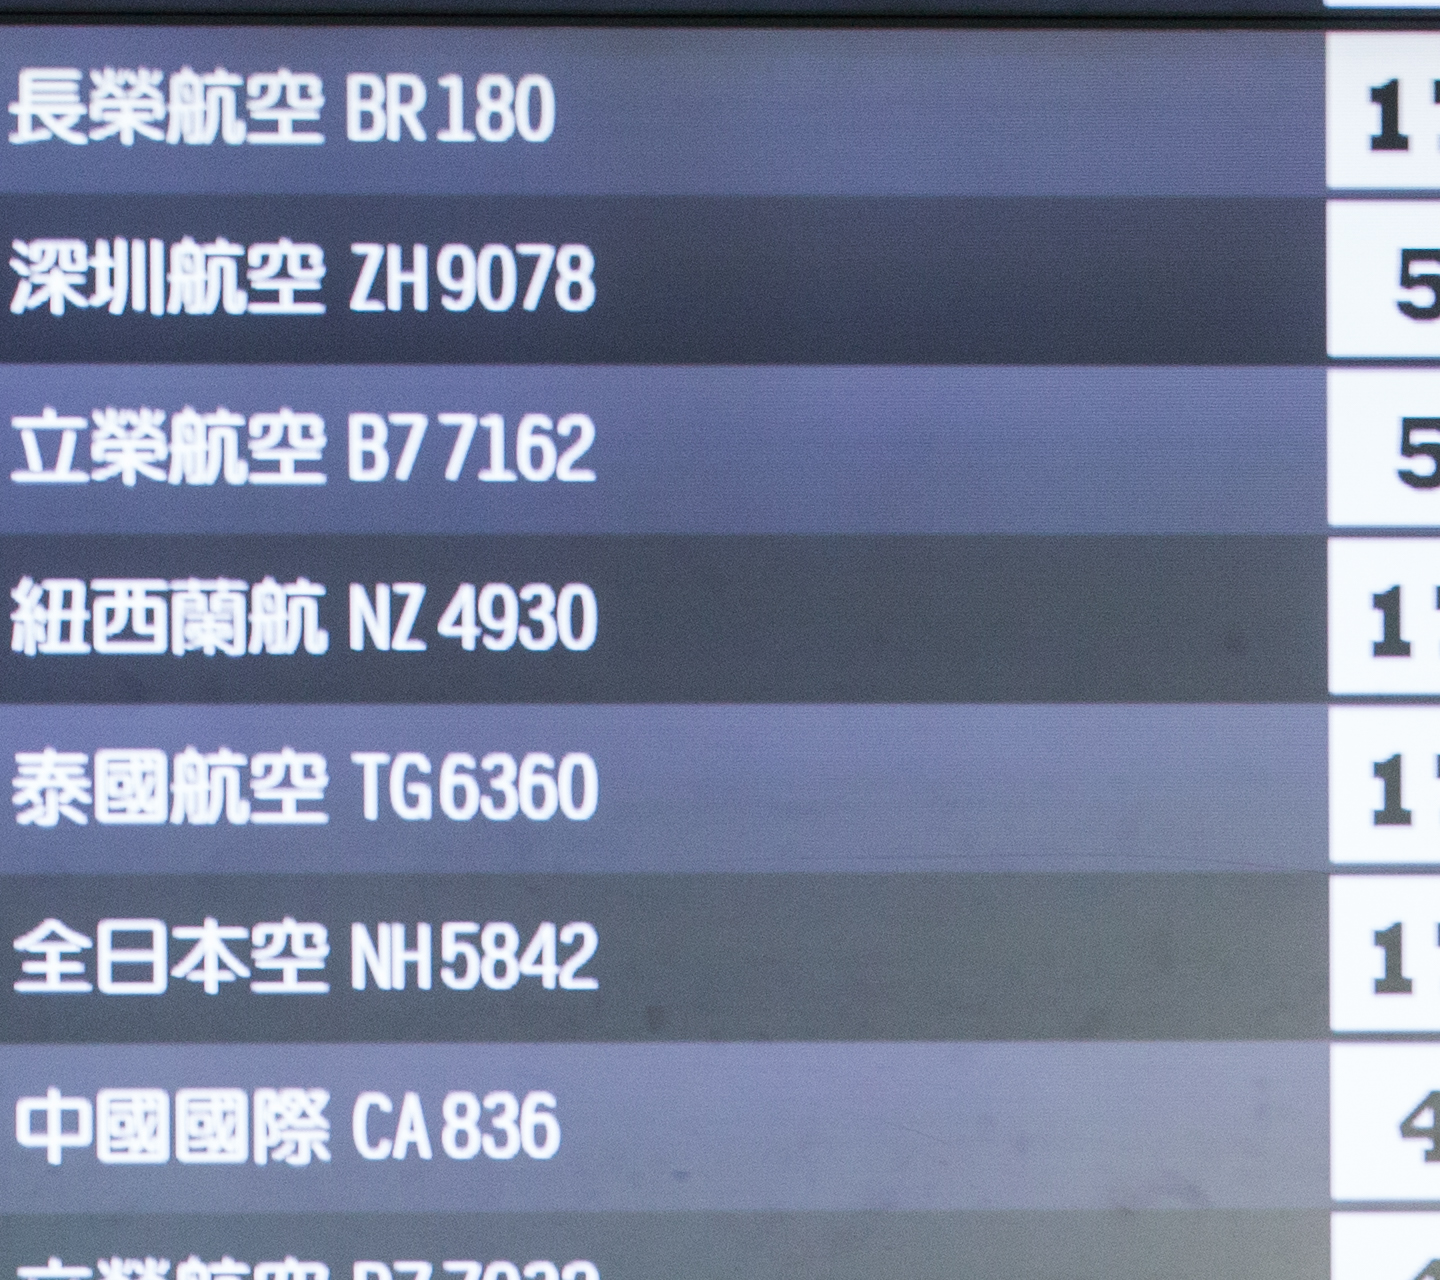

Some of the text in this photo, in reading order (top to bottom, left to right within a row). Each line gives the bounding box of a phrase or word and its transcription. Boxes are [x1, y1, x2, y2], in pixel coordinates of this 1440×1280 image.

[7, 66, 326, 147] 長榮航空
[8, 236, 327, 317] 深圳航空
[9, 406, 328, 488] 立榮航空
[9, 576, 330, 657] 紐西蘭航
[11, 745, 330, 828] 泰國航空
[12, 916, 331, 996] 全日本空
[14, 1085, 333, 1167] 中國國際
